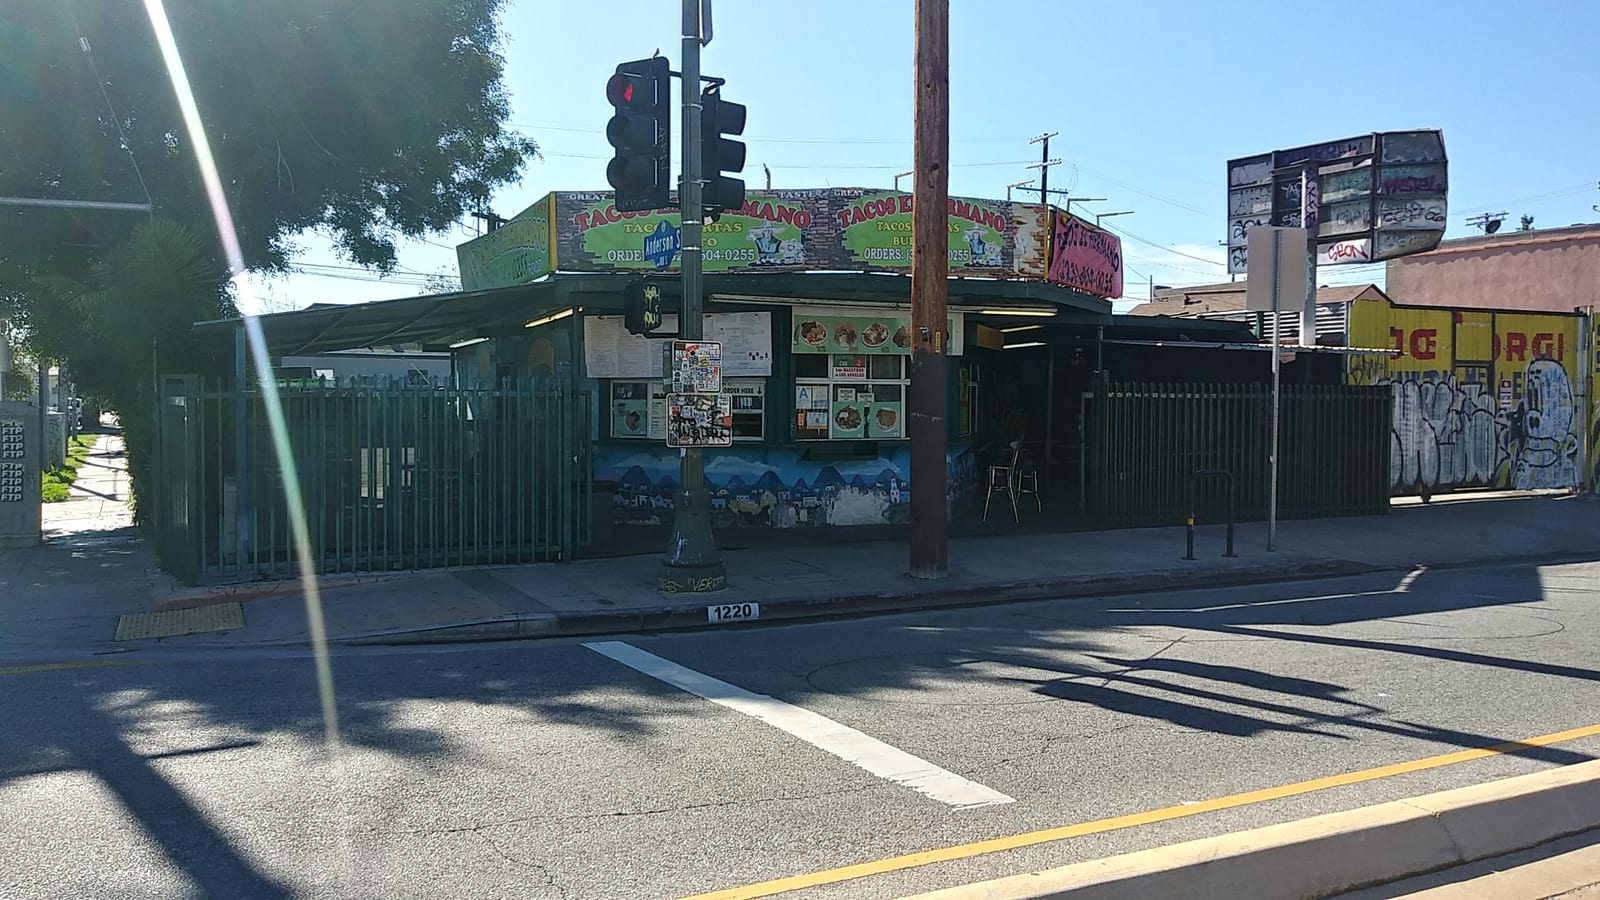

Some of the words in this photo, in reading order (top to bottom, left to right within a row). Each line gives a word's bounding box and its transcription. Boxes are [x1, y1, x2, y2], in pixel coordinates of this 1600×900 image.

[569, 193, 607, 201] GREAT
[779, 190, 817, 199] TASTE
[837, 196, 897, 229] TACOS
[645, 235, 674, 257] Anderson
[675, 229, 681, 249] S
[799, 387, 808, 399] A
[2, 427, 23, 435] FTP
[2, 435, 23, 443] FTP
[2, 442, 24, 451] FTP
[3, 450, 24, 459] FTP
[1, 470, 22, 478] FTP
[1, 478, 22, 486] FTP
[1, 485, 22, 494] FTP
[1, 493, 22, 501] FTP
[714, 604, 752, 620] 1220
